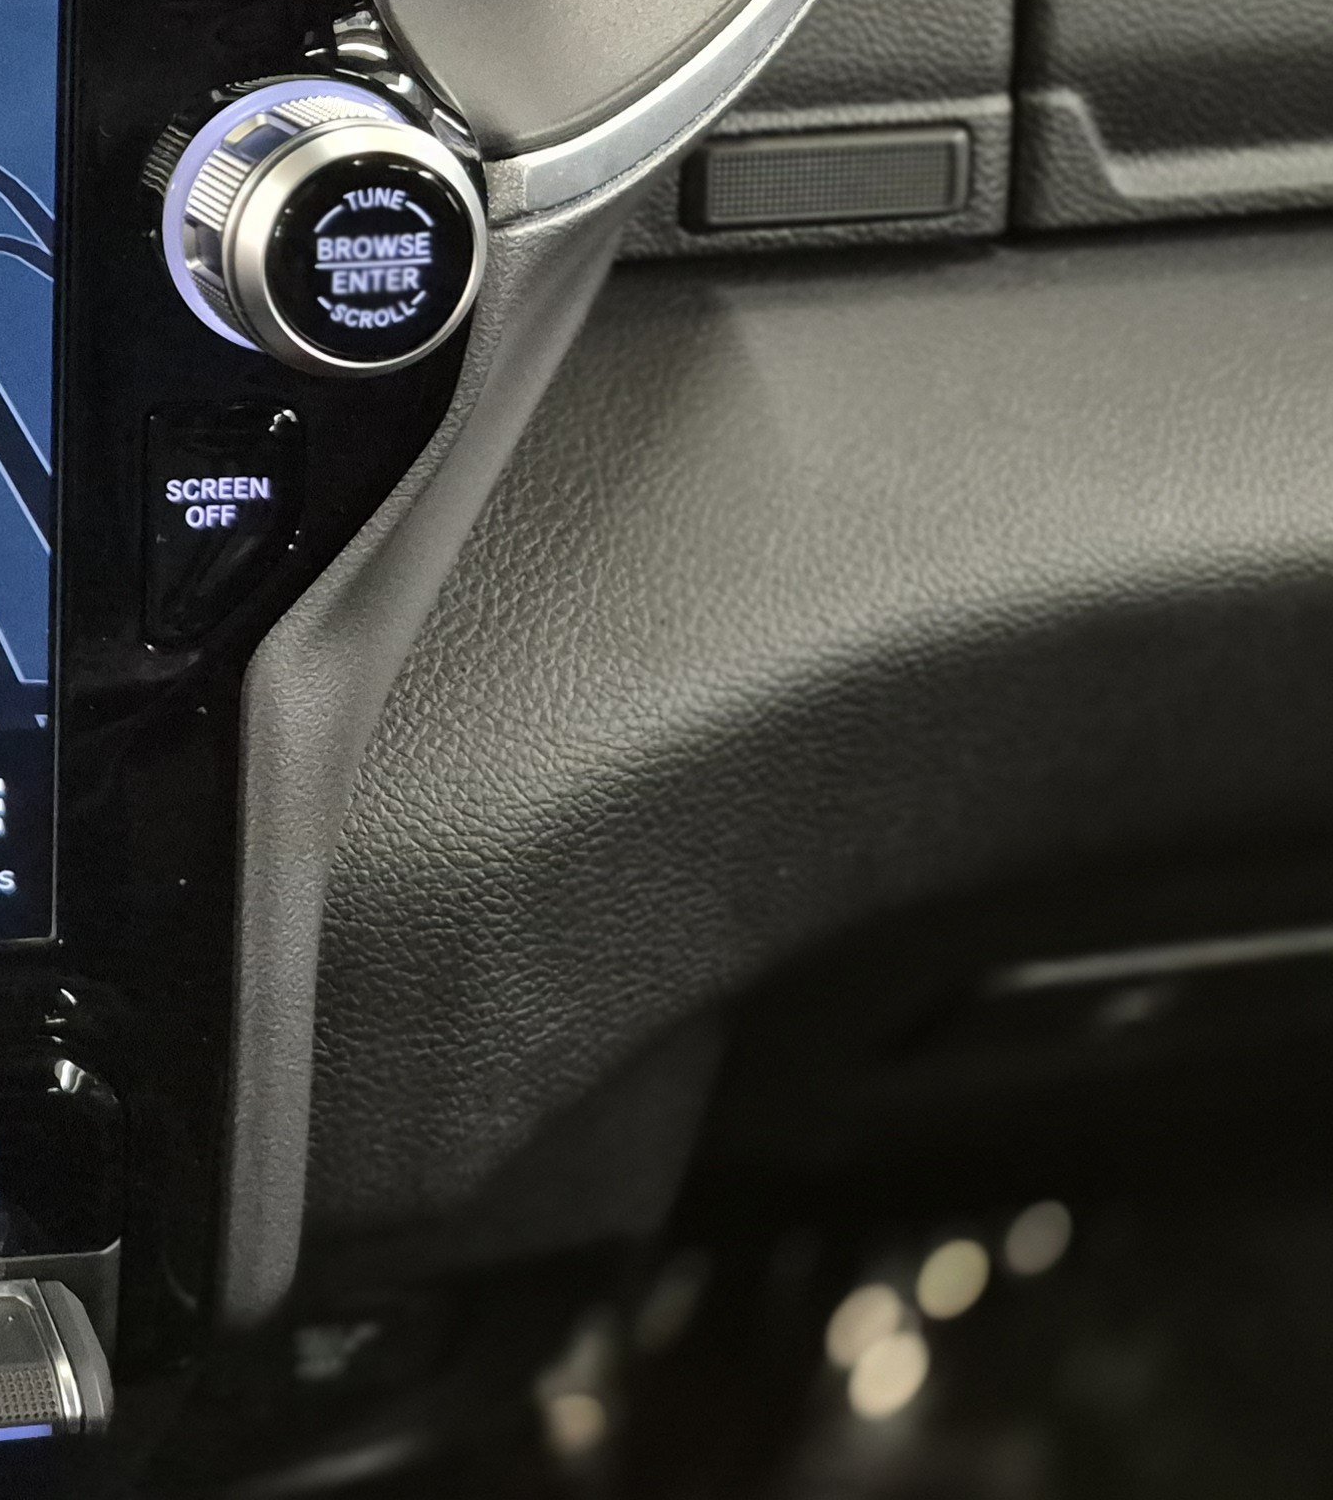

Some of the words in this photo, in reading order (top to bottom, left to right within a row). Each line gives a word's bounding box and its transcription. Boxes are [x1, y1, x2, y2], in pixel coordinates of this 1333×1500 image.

[343, 186, 407, 212] TUNE
[316, 231, 432, 262] BROWSE
[331, 265, 420, 295] ENTER
[329, 300, 418, 330] SCROLL
[165, 476, 271, 503] SCREEN
[184, 504, 237, 529] OFF
